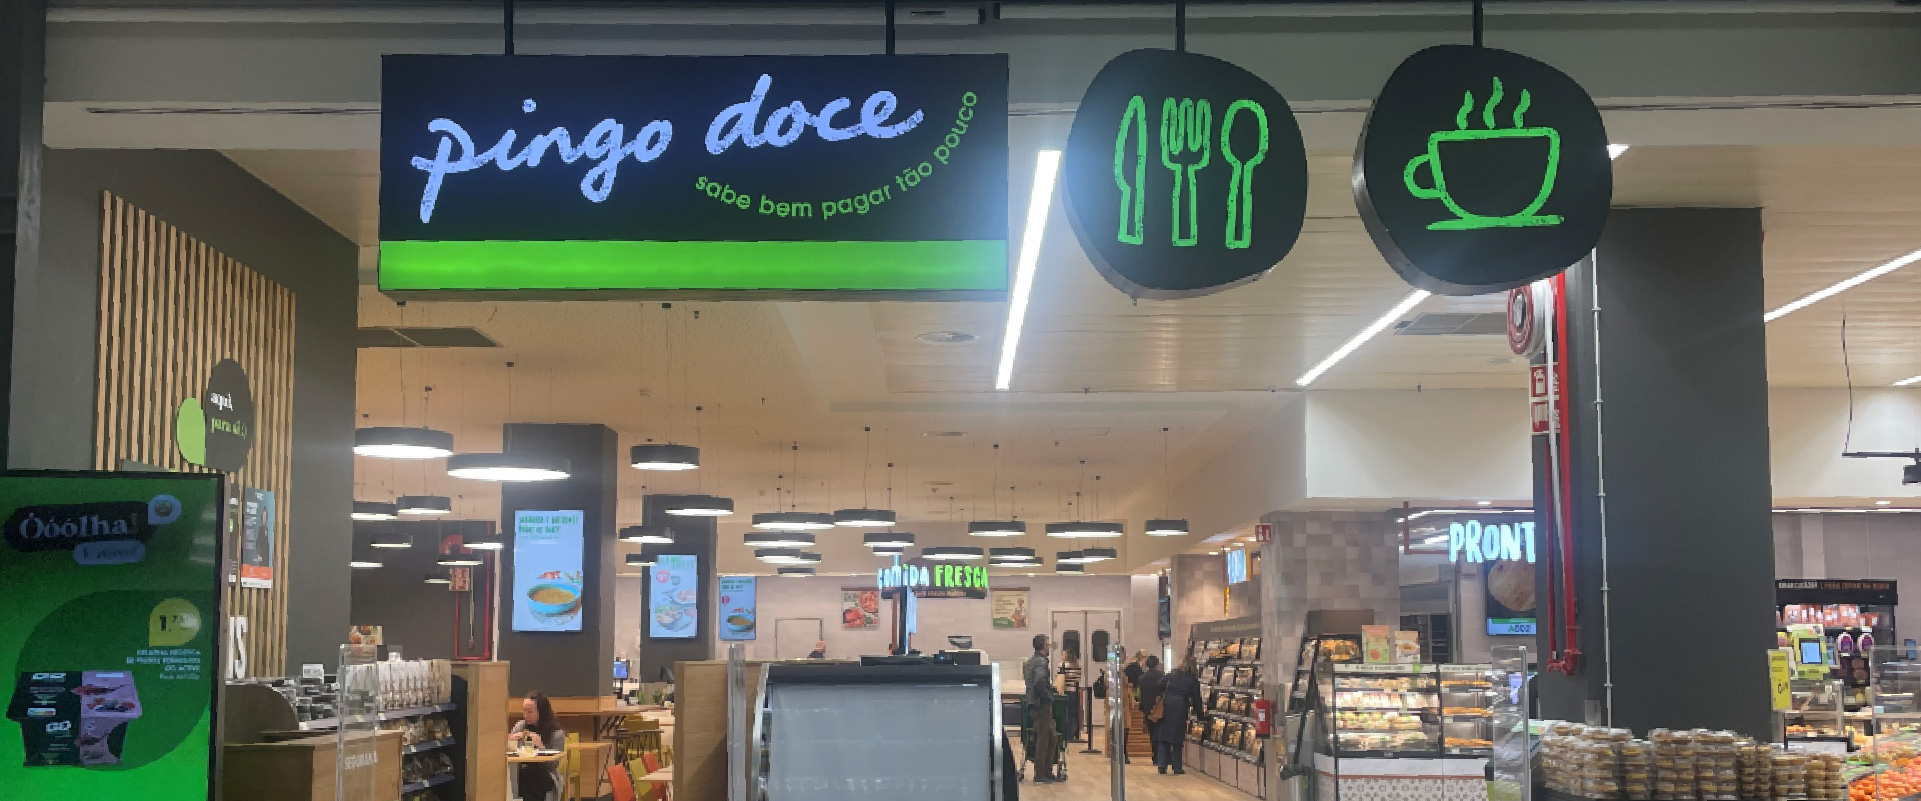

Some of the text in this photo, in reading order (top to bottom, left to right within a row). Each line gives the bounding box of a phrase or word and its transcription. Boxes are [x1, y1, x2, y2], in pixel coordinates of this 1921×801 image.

[412, 73, 925, 224] pingo doce
[695, 91, 978, 220] sabe bem pagar tão pouco
[934, 564, 989, 588] FRESCA
